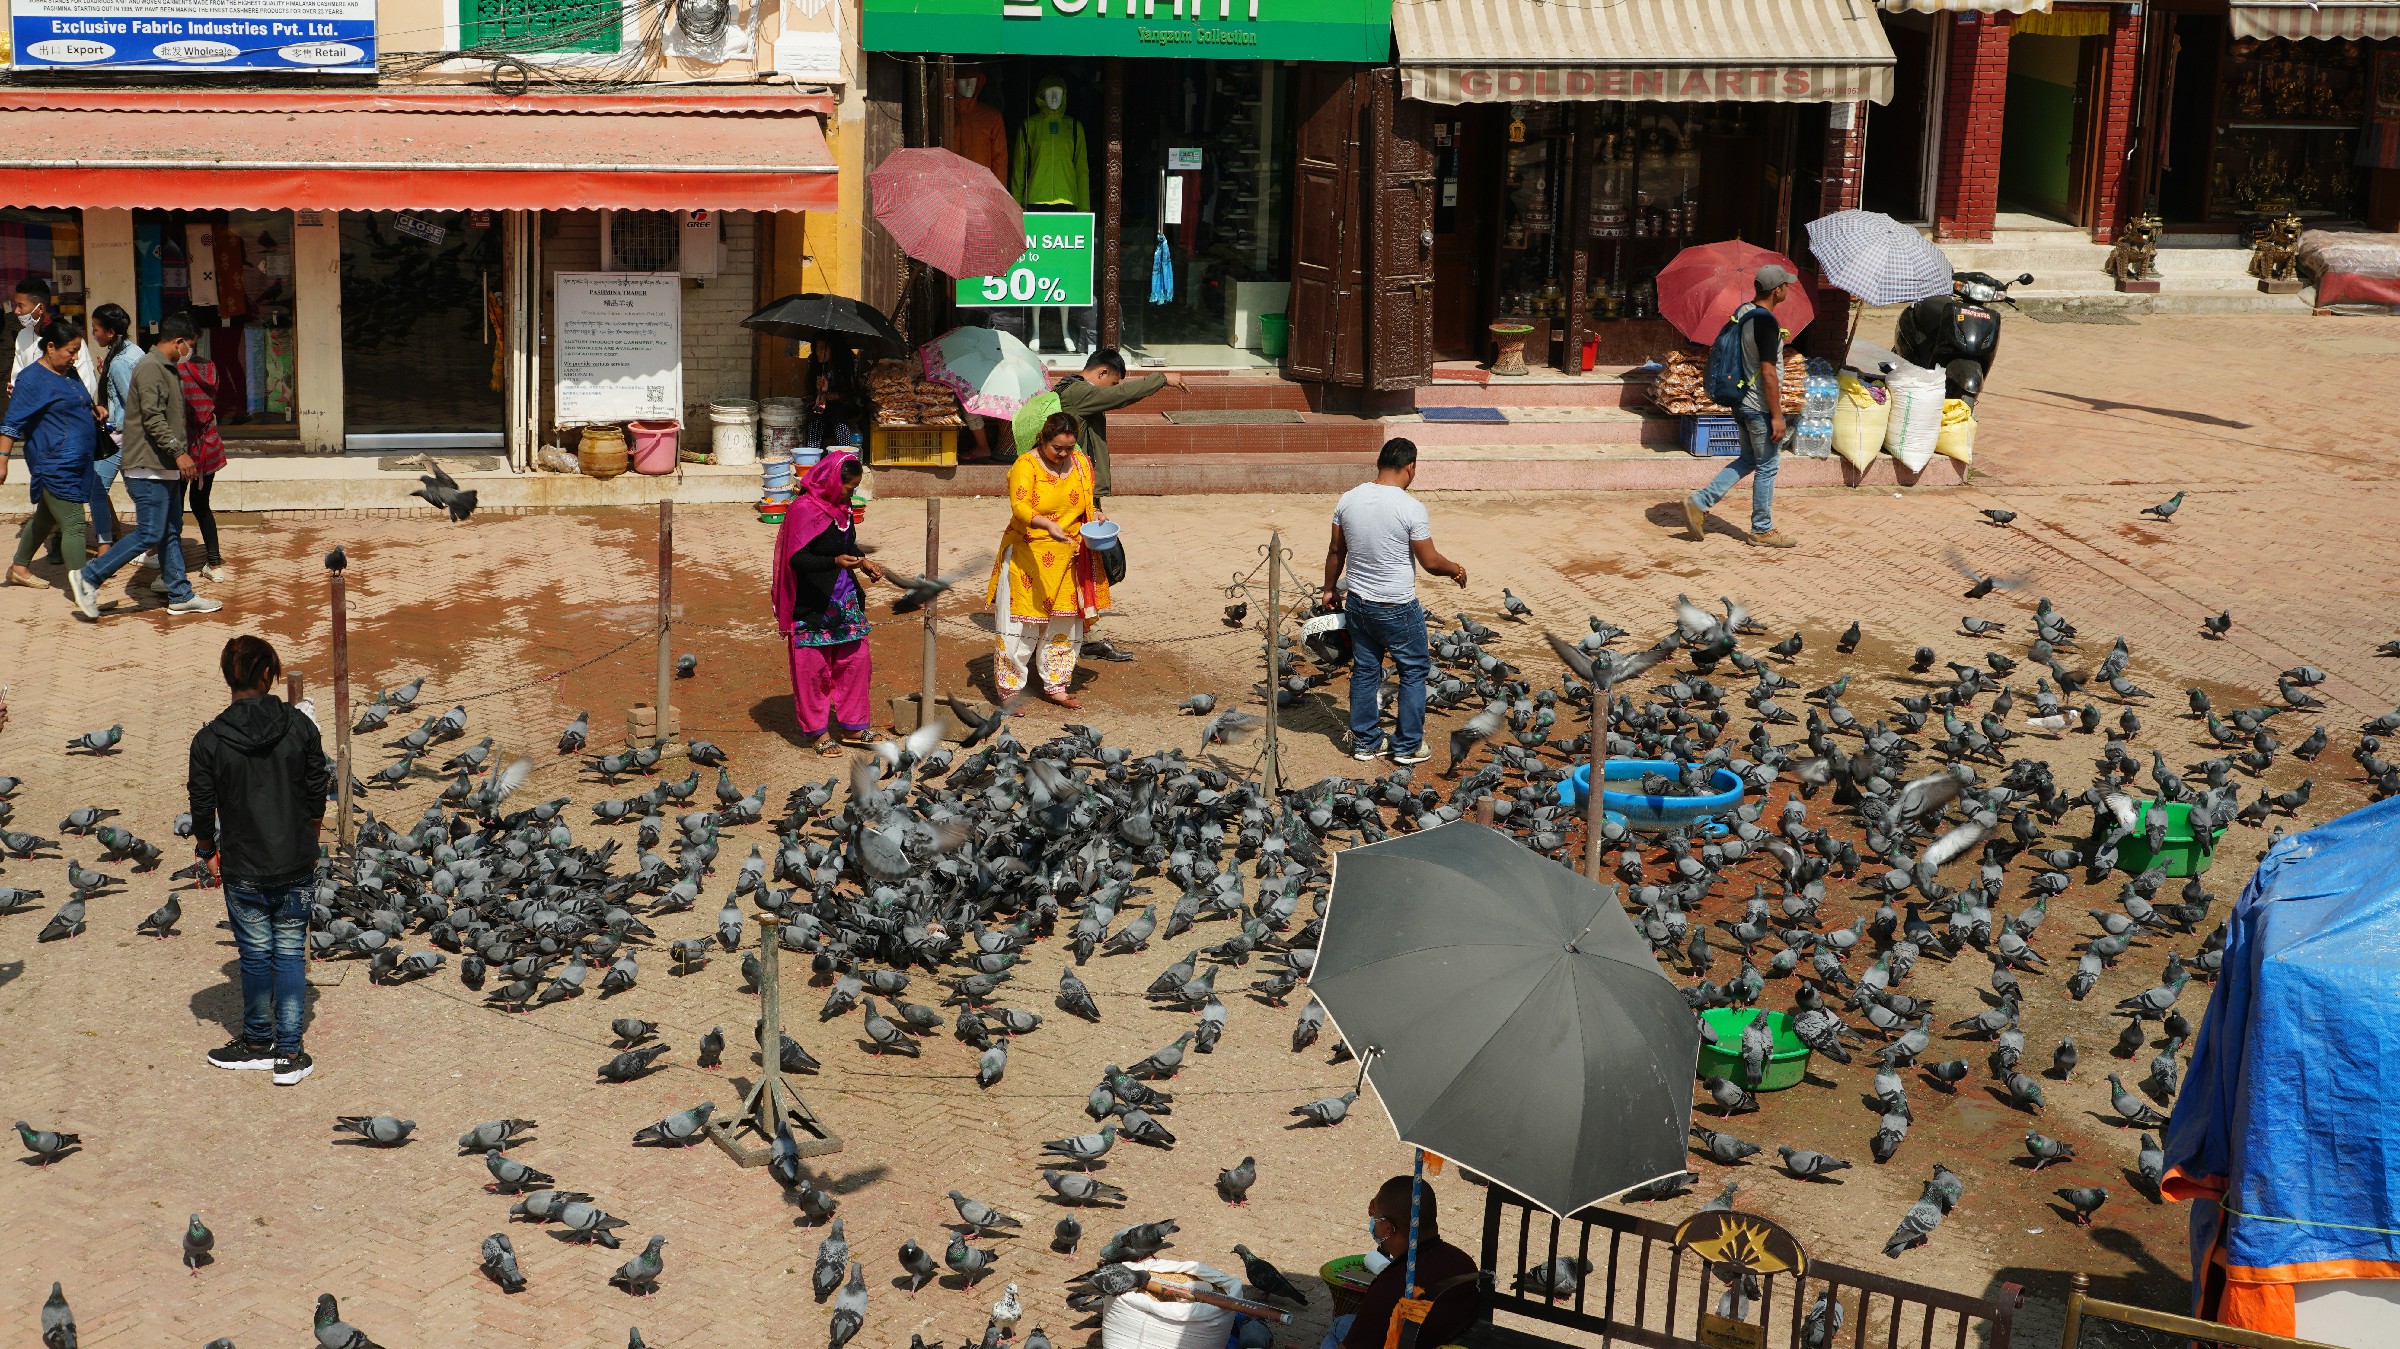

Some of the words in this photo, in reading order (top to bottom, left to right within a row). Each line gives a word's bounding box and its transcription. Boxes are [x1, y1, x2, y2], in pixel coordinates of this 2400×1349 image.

[52, 20, 126, 34] Exclusive
[132, 21, 182, 34] Fabric
[189, 22, 267, 36] Industries
[273, 23, 303, 36] Pvt.
[309, 23, 338, 36] Ltd.
[1138, 27, 1192, 45] Yangzom
[1197, 28, 1257, 45] Collection
[39, 45, 61, 57] 出口
[67, 45, 104, 57] Export
[161, 46, 182, 57] 批发
[184, 47, 233, 57] Wholesale
[315, 48, 346, 57] Retail
[1460, 71, 1663, 96] GOLDEN
[1678, 71, 1810, 96] ARTS
[399, 216, 443, 237] CLOSE
[1042, 234, 1085, 249] SALE
[1029, 252, 1040, 262] to
[981, 267, 1067, 302] 50%
